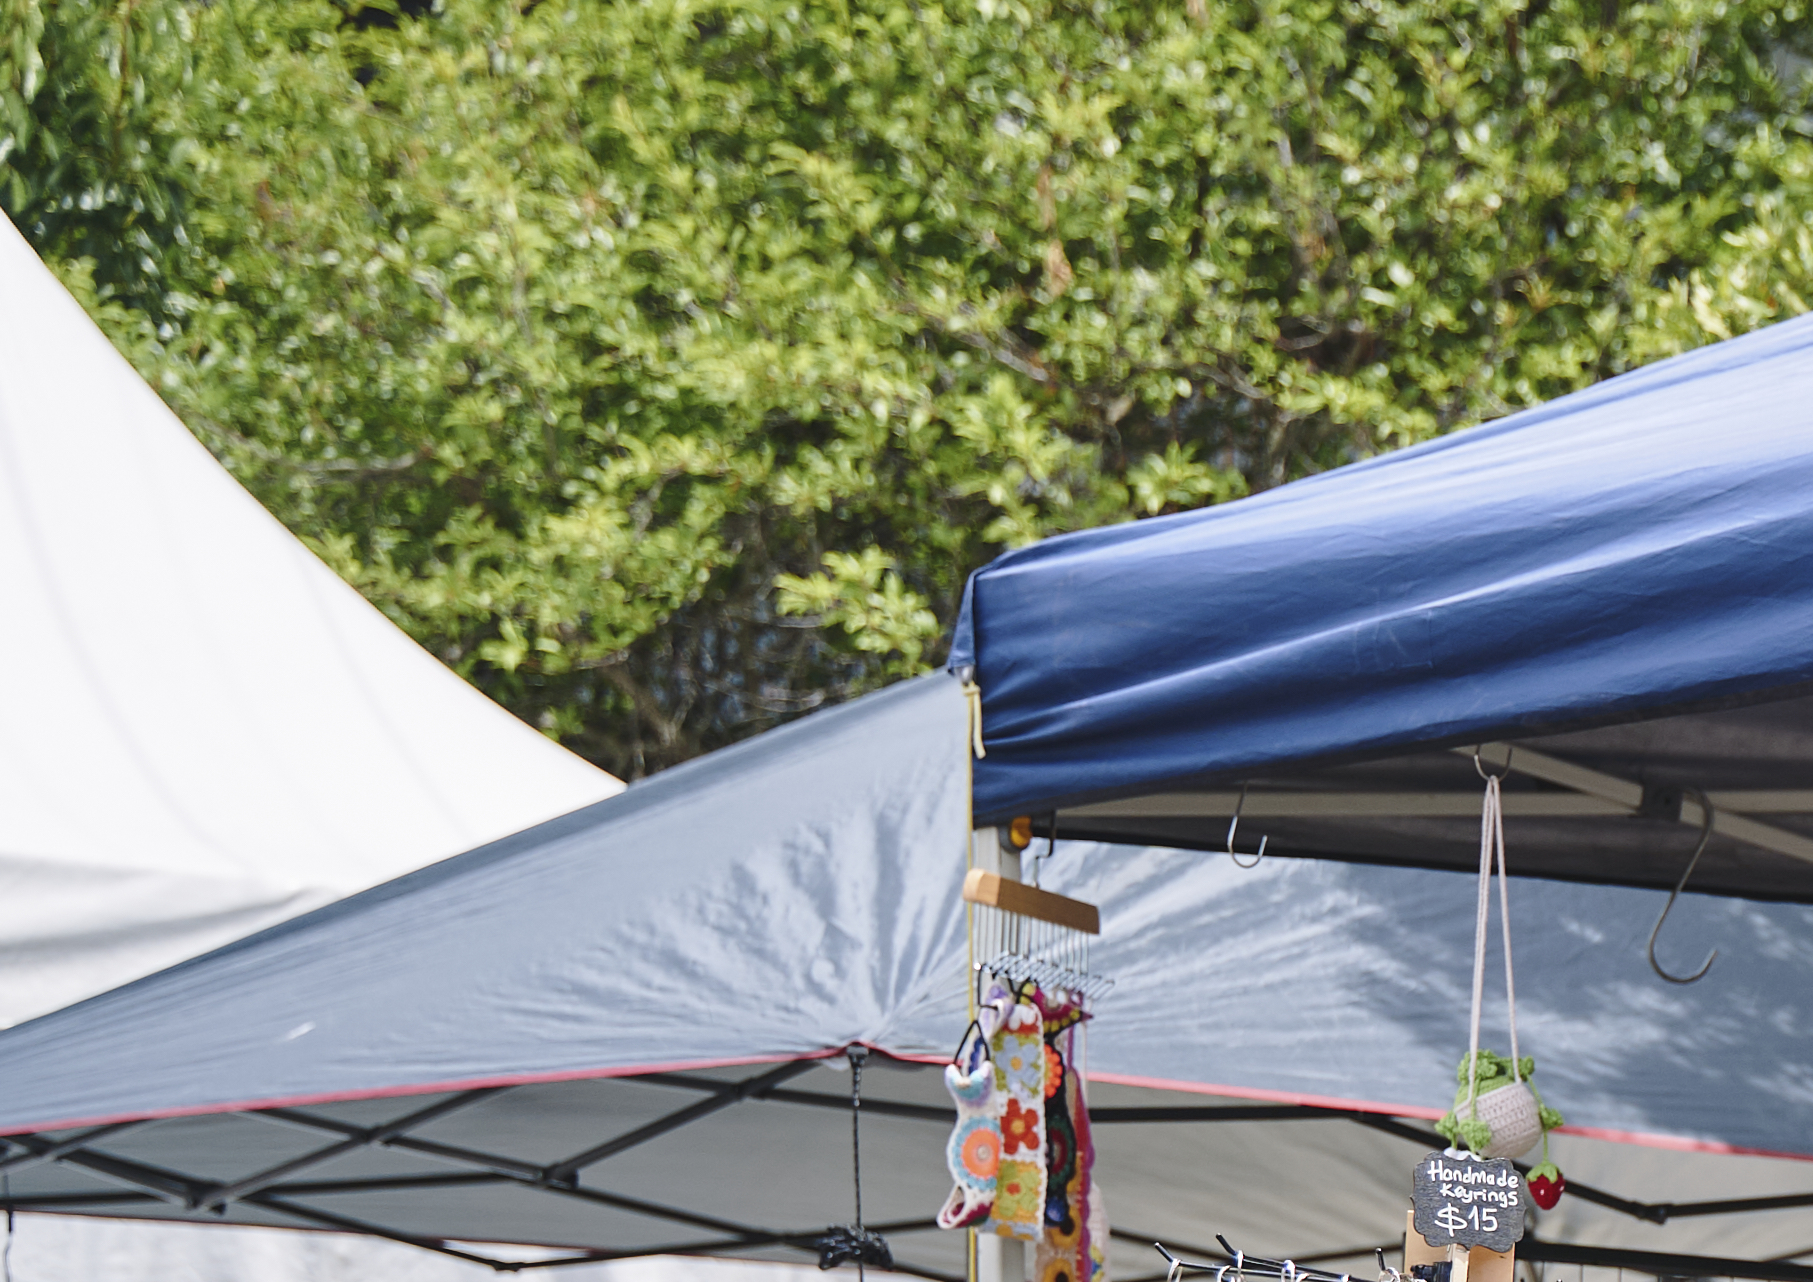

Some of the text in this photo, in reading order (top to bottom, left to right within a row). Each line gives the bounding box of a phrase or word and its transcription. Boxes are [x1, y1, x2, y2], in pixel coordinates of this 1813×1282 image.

[1427, 1159, 1520, 1189] Handmade
[1439, 1182, 1519, 1209] Keyrings
[1434, 1202, 1498, 1238] $15
